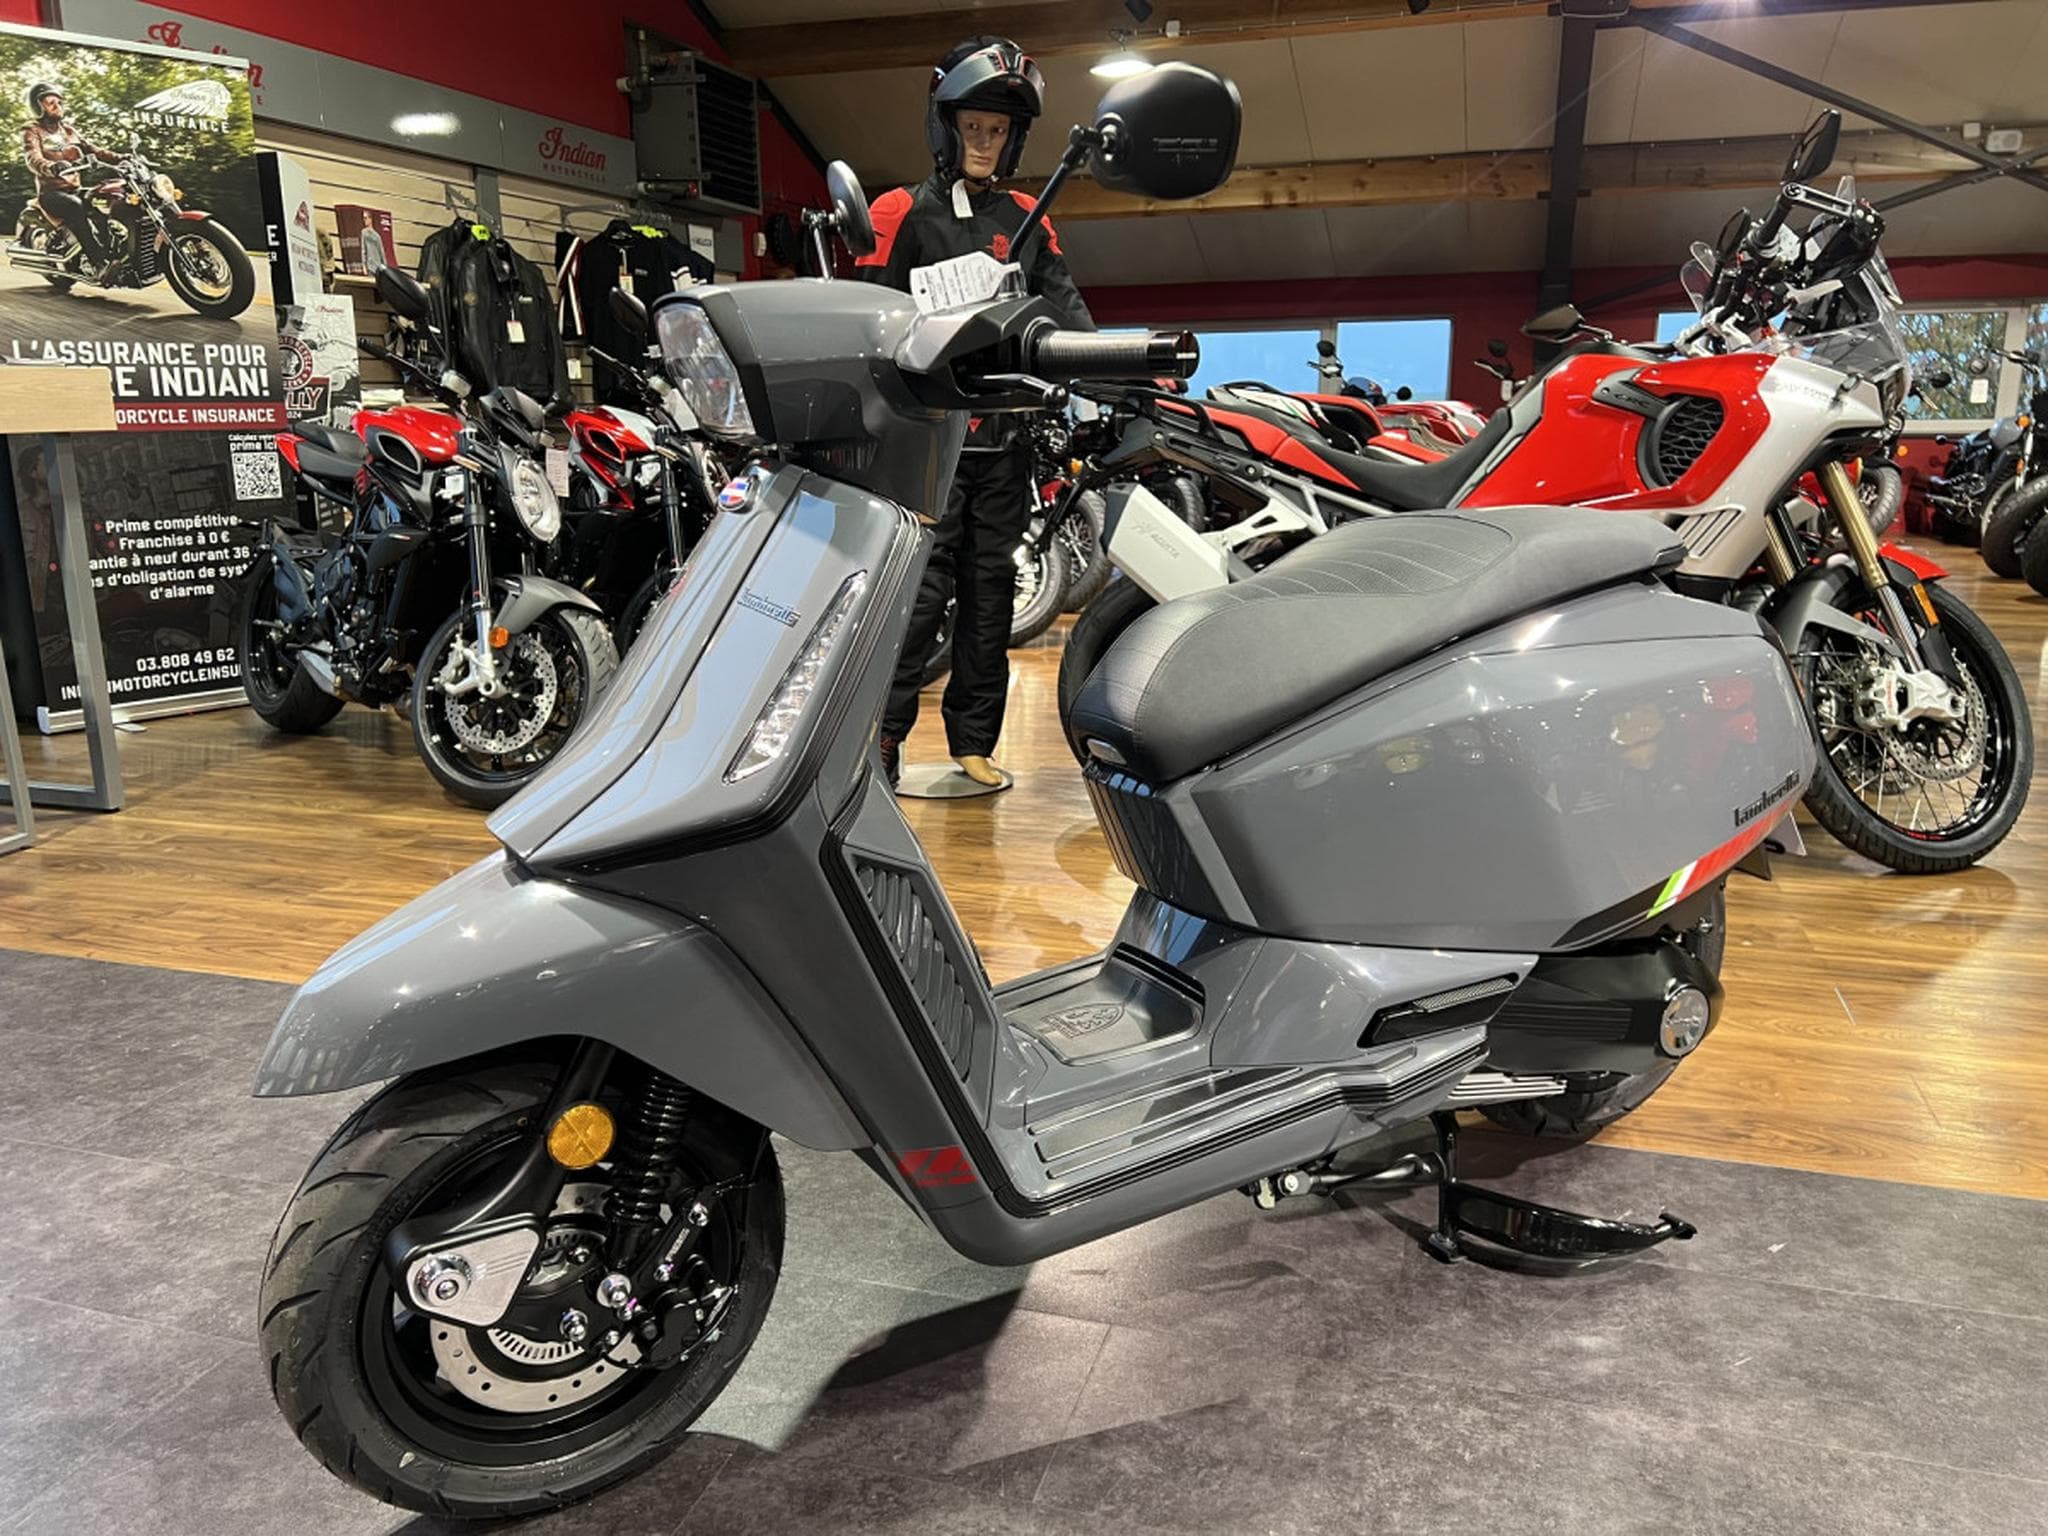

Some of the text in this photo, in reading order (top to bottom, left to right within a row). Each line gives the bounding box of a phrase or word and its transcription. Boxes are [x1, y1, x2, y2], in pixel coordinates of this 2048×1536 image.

[133, 110, 230, 134] INSURANCE
[539, 127, 606, 171] Indian
[11, 339, 267, 366] L'ASSURANCE POUR
[152, 366, 270, 397] INDIAN!
[286, 386, 324, 411] LLY
[116, 408, 276, 425] ORCYCLE INSURANCE
[230, 441, 262, 452] prime
[105, 519, 150, 534] Prime
[118, 531, 231, 550] Franchise à 0 €
[89, 546, 250, 570] antie à neuf durant 36
[107, 567, 196, 586] d'obligation
[199, 563, 216, 578] de
[219, 563, 249, 579] syst
[149, 583, 215, 600] d'alarme
[135, 648, 236, 673] 03.808 49 62
[1734, 769, 1800, 827] Lambretta
